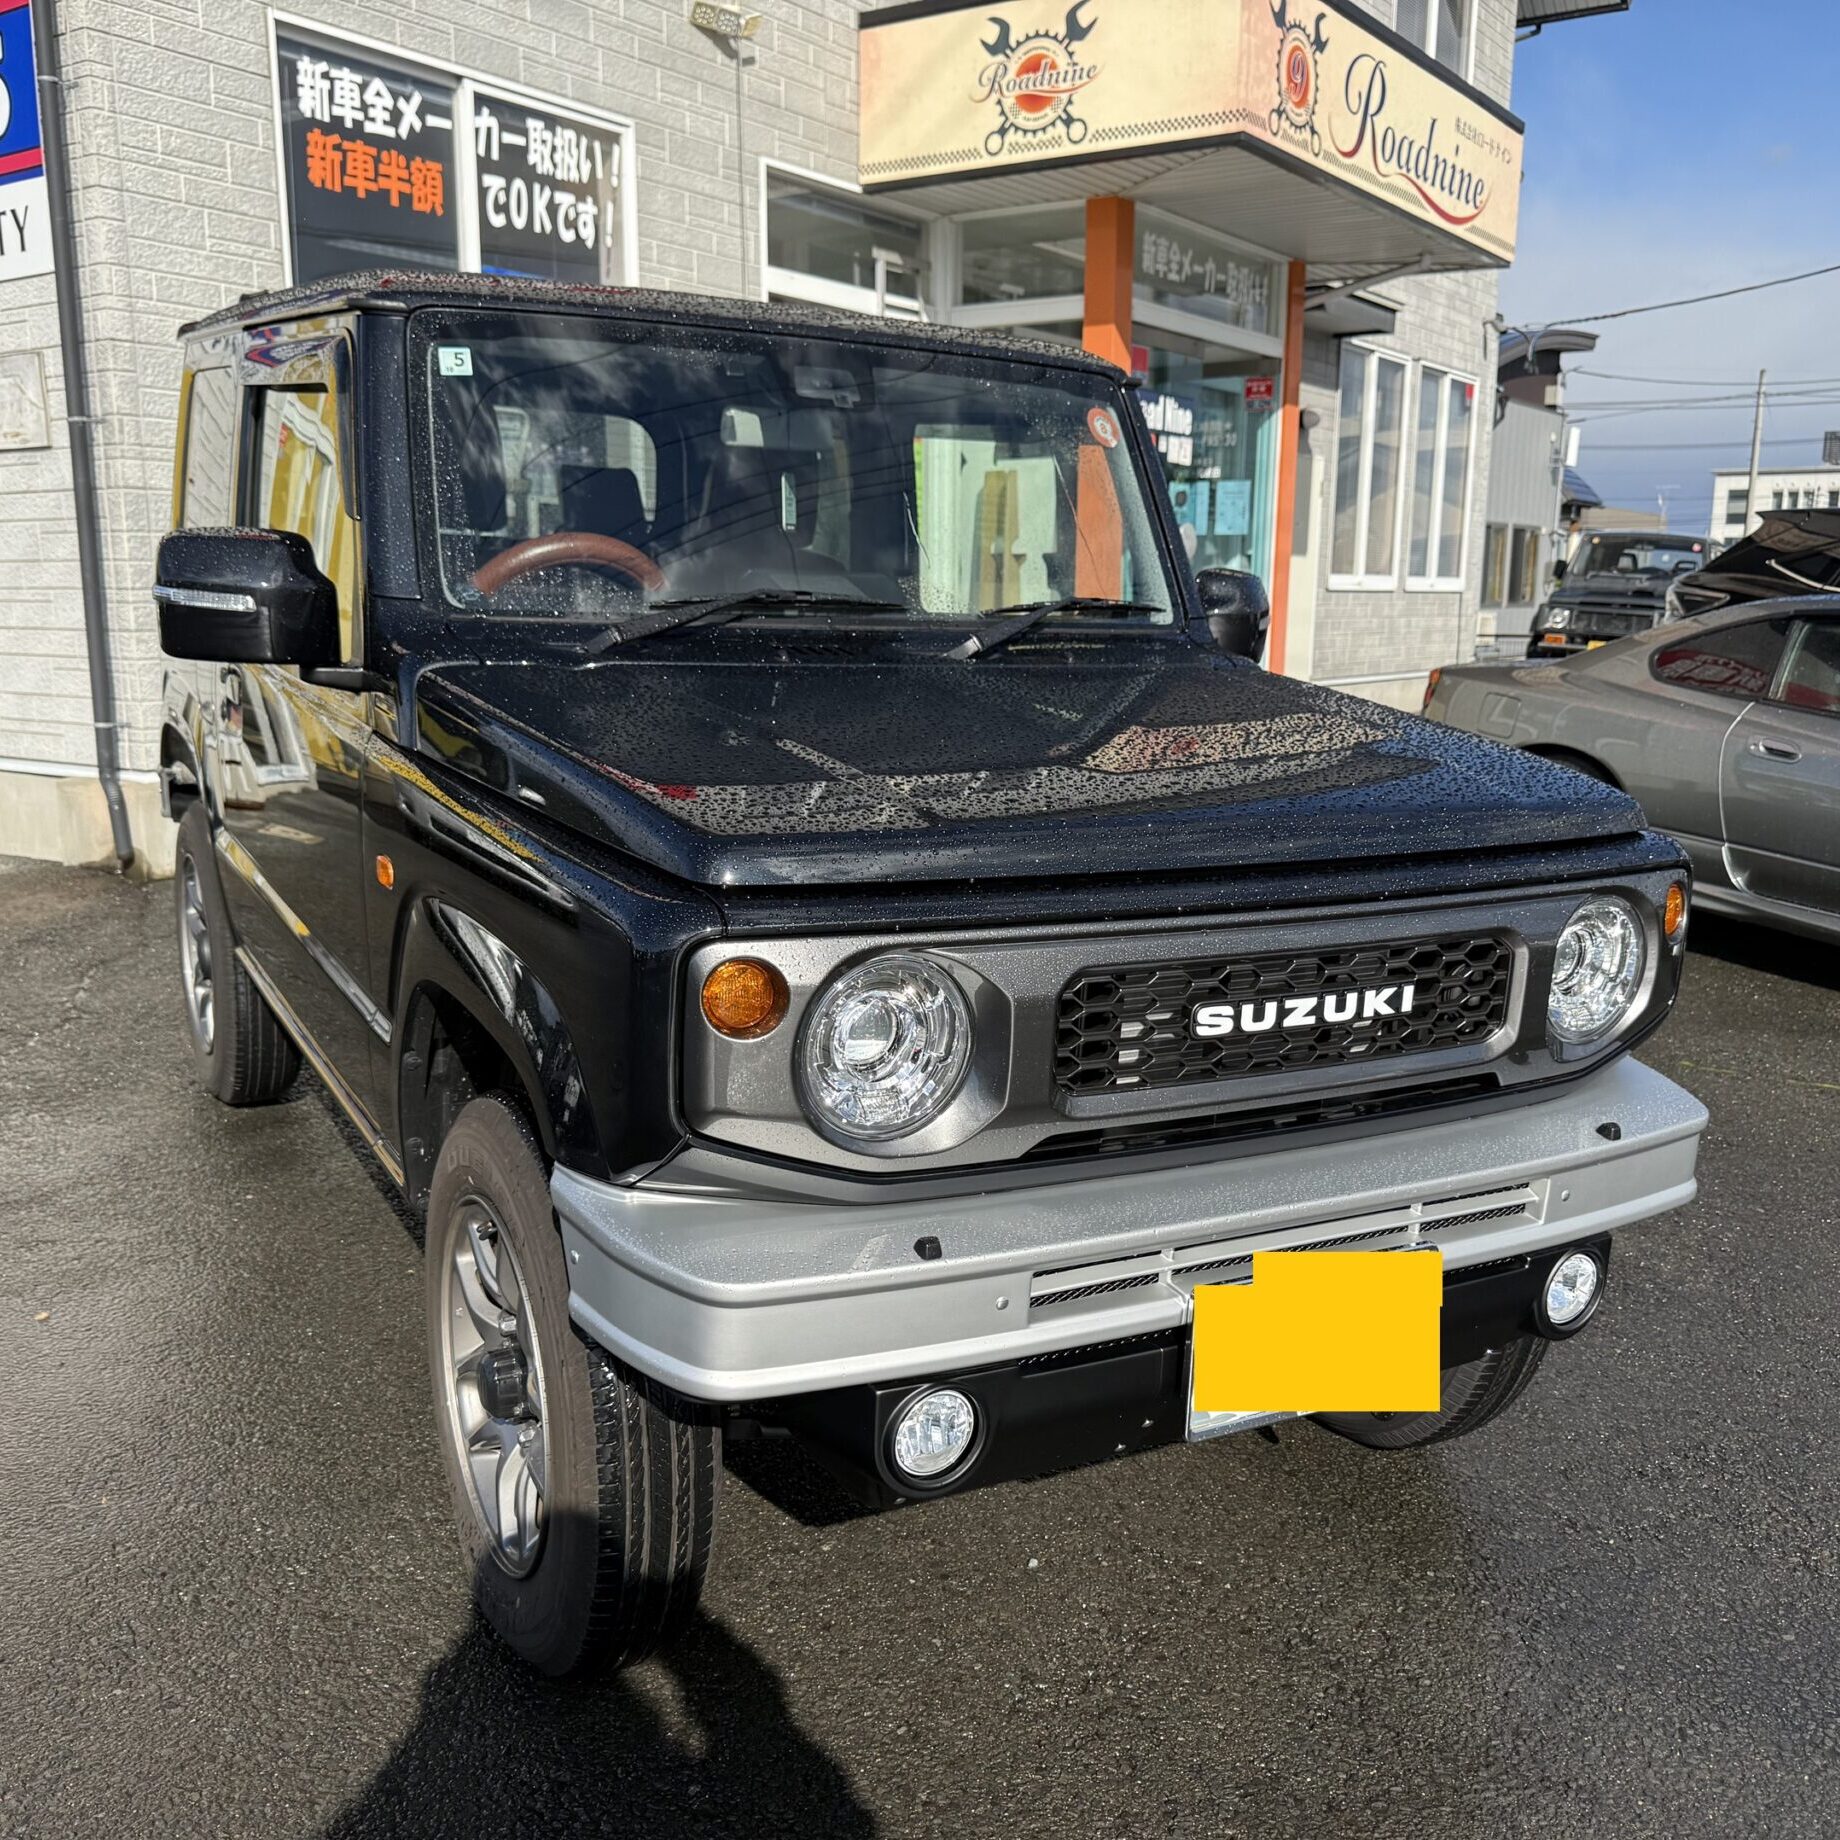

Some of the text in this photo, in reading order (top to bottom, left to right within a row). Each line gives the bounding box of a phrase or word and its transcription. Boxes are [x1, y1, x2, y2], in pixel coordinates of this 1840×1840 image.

[969, 59, 1100, 103] Roadnine
[1328, 53, 1486, 212] Roadnine
[454, 352, 465, 367] 5
[1195, 984, 1415, 1037] SUZUKI
